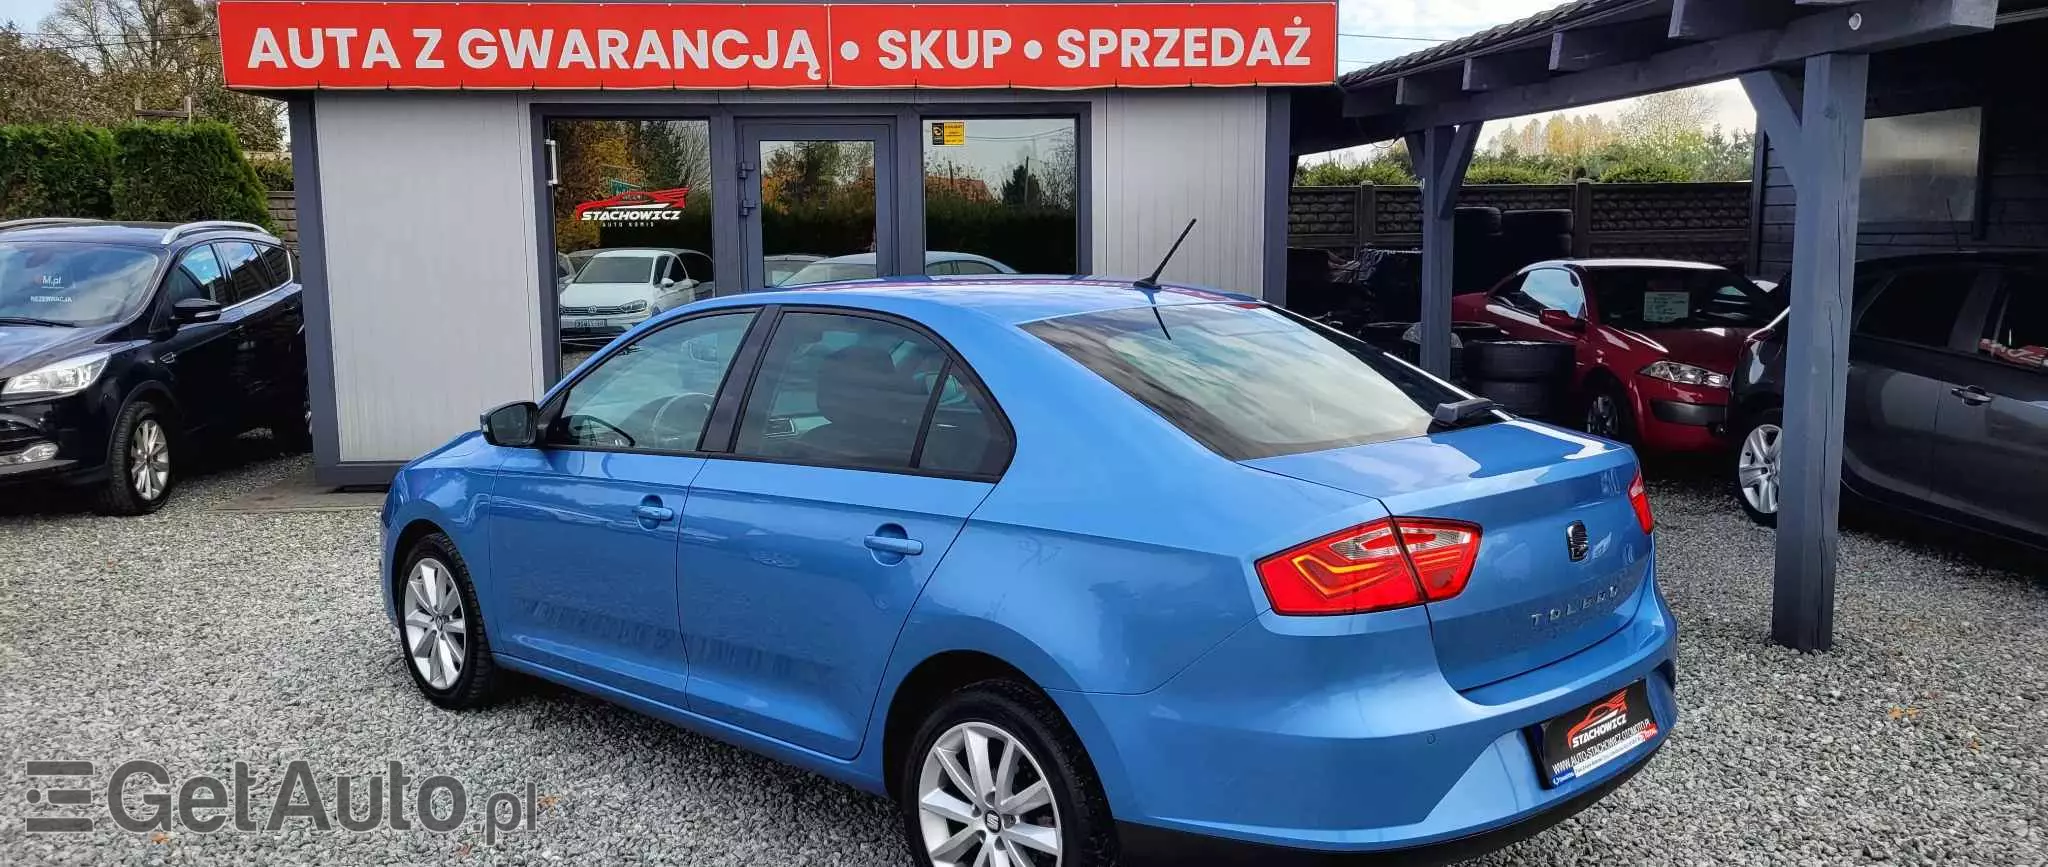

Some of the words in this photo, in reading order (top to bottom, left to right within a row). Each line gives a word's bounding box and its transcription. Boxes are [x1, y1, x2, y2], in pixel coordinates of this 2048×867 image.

[247, 27, 402, 69] AUTA
[412, 28, 445, 69] Z
[457, 28, 822, 80] GWARANCJĄ
[877, 29, 1012, 69] SKUP
[1057, 16, 1311, 68] SPRZEDAŻ
[581, 210, 682, 221] STACHOWICZ
[1572, 713, 1628, 749] STACHOWICZ
